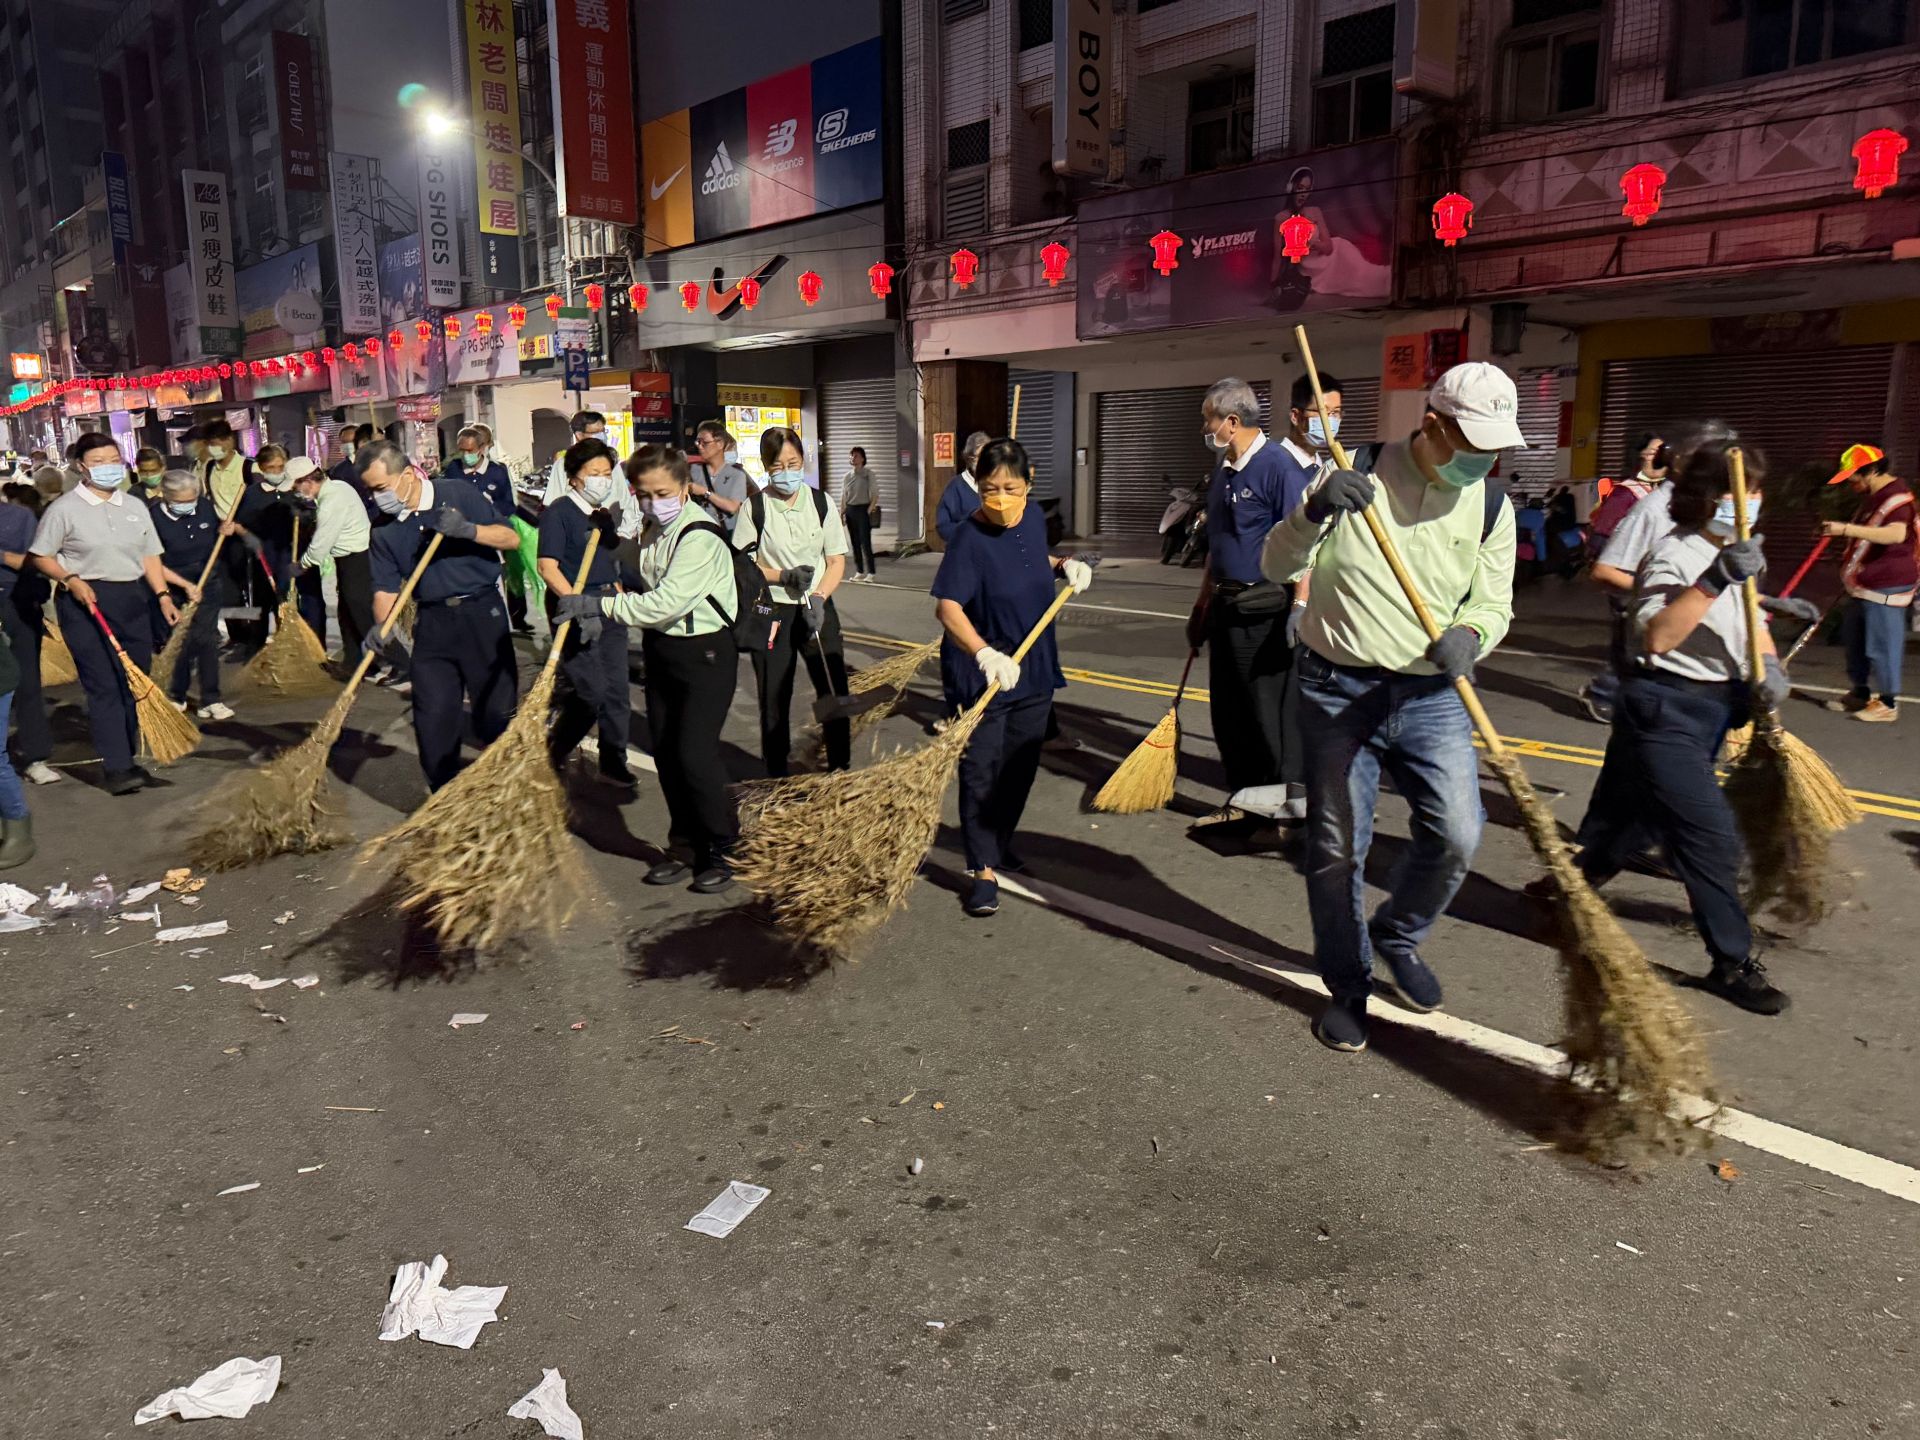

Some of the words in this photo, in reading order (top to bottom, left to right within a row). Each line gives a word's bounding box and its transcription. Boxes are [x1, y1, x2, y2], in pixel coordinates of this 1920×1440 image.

[1079, 30, 1100, 130] BOY
[287, 61, 305, 137] SHISEIDO
[819, 128, 876, 154] SKECHERS
[109, 176, 128, 211] BLUE
[701, 171, 740, 195] adidas
[112, 212, 132, 243] WAY
[428, 190, 450, 265] SHOES
[1203, 228, 1258, 251] PLAYBOY
[199, 210, 228, 315] 阿瘦皮鞋
[356, 266, 378, 317] 越式洗頭
[291, 308, 317, 320] Bear
[467, 338, 478, 353] PG
[479, 335, 505, 352] SHOES
[1389, 345, 1415, 366] 租
[568, 352, 585, 372] P
